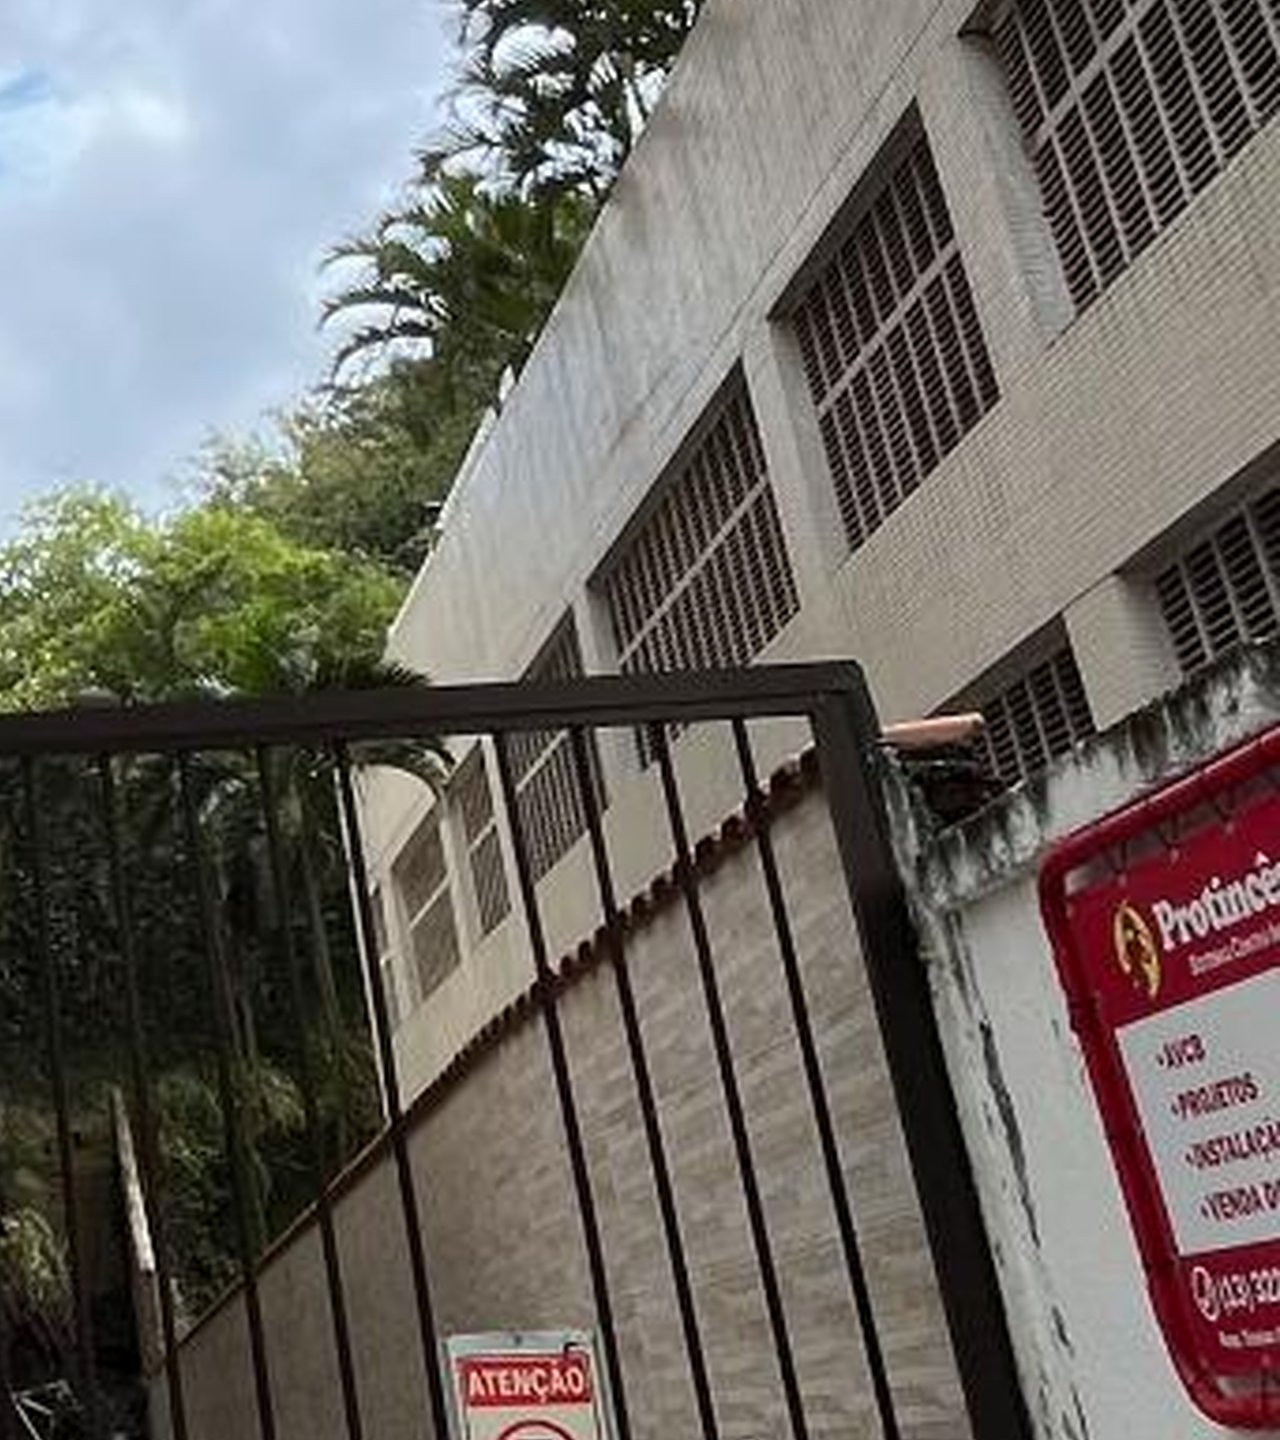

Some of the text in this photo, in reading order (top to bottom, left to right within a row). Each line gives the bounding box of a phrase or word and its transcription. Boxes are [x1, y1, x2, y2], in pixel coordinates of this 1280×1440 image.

[1151, 851, 1280, 952] Protincê
[1177, 1075, 1258, 1119] PROJETOS
[1204, 1178, 1280, 1223] VENDA D
[468, 1360, 585, 1404] ATENÇÃO
